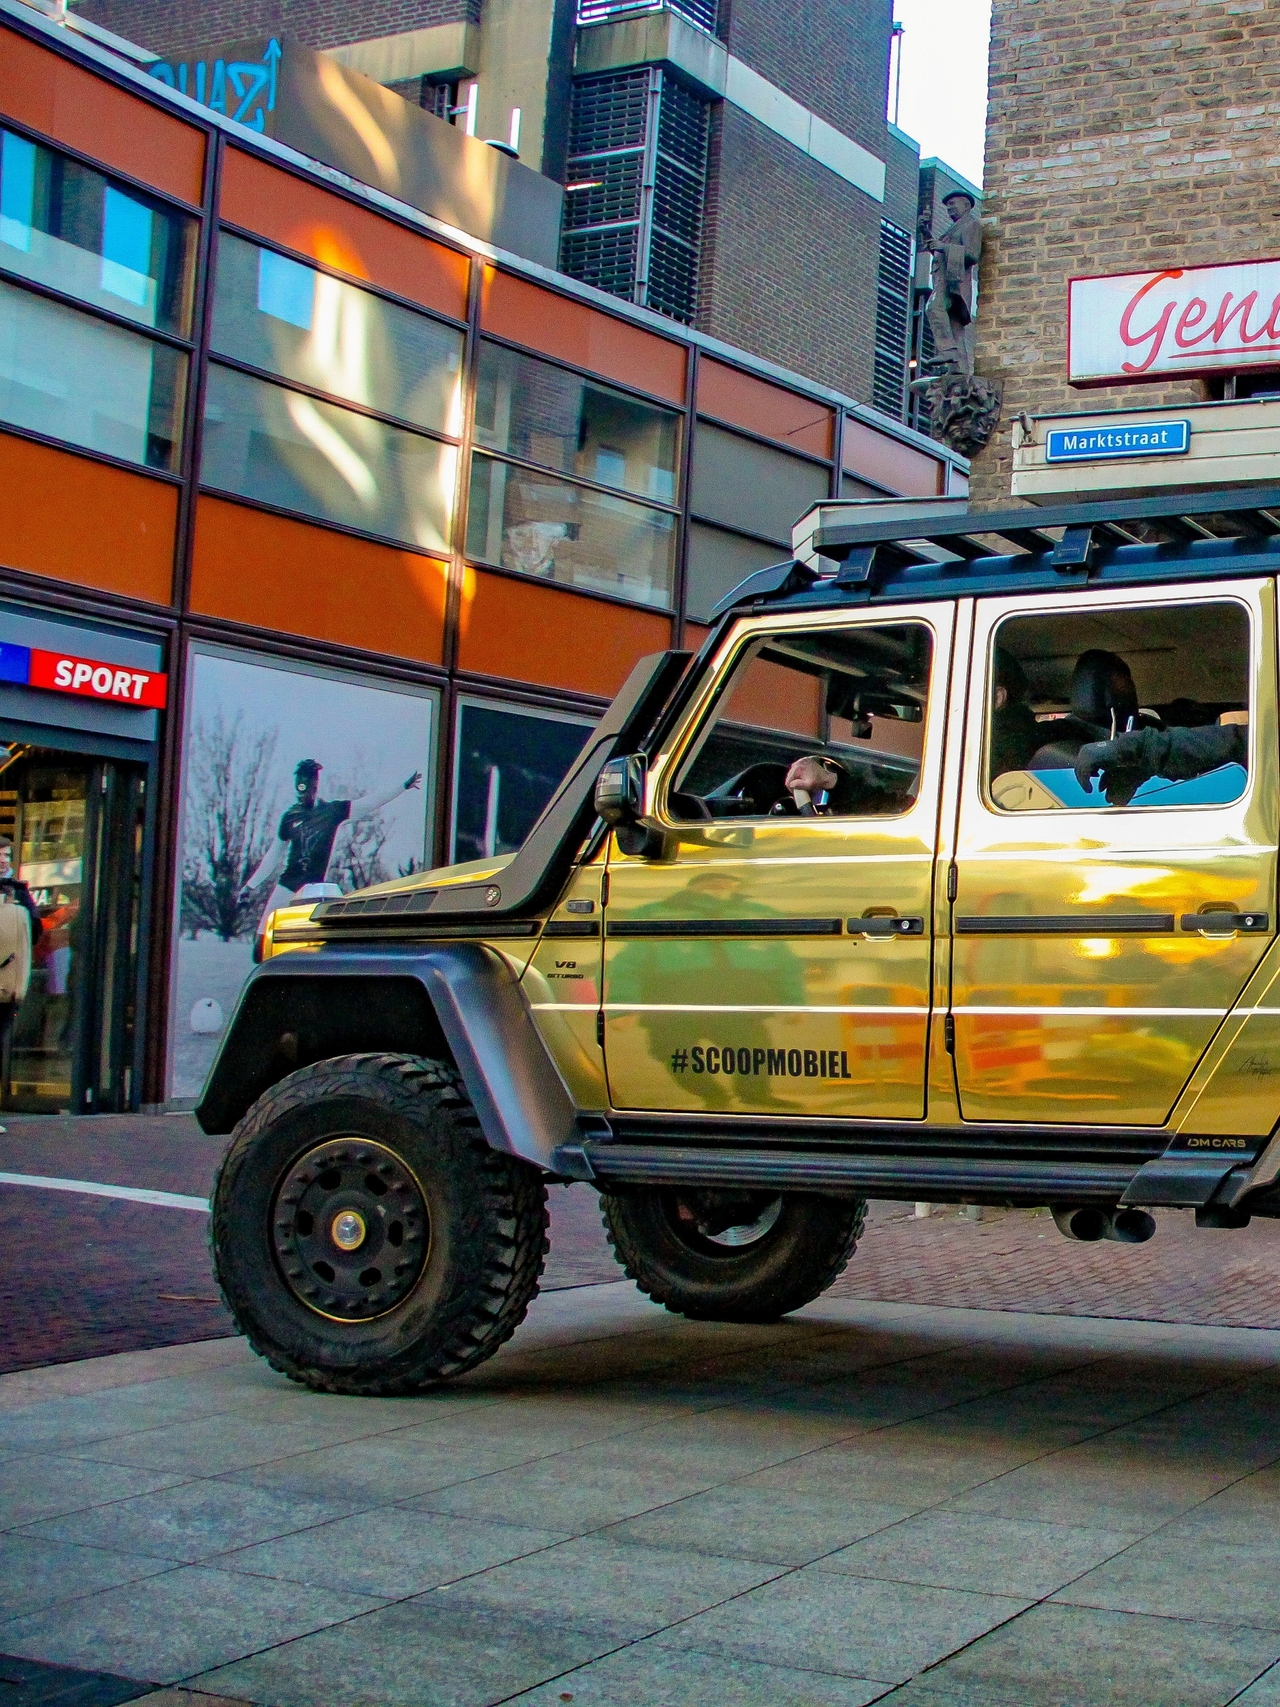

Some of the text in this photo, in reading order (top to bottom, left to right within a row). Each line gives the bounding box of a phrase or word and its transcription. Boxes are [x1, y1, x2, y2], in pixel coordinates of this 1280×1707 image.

[1063, 430, 1168, 450] Marktstraat
[54, 660, 149, 699] SPORT
[555, 961, 577, 969] V8
[671, 1046, 851, 1079] #SCOOPMOBIEL
[1212, 1138, 1246, 1148] CARS
